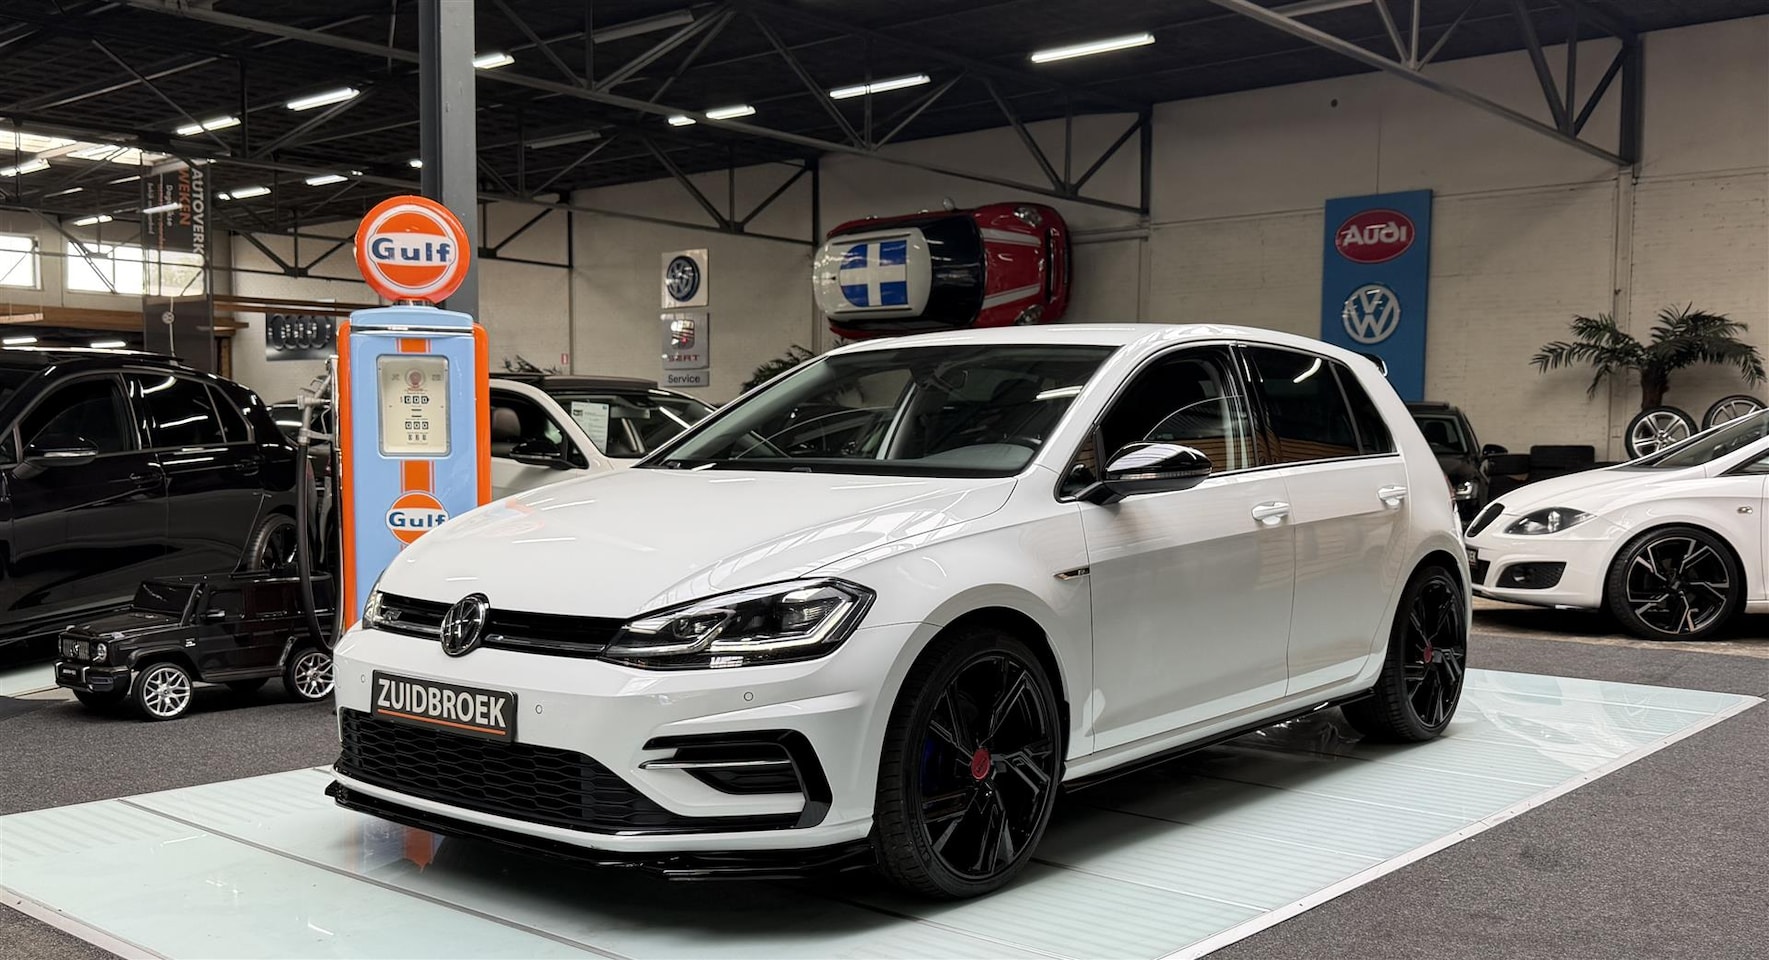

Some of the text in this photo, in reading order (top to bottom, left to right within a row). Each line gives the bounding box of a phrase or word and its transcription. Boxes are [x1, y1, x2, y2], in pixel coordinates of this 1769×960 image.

[371, 236, 451, 263] Gulf
[667, 373, 701, 384] Service
[388, 511, 446, 528] Gulf
[376, 677, 507, 728] ZUIDBROEK
